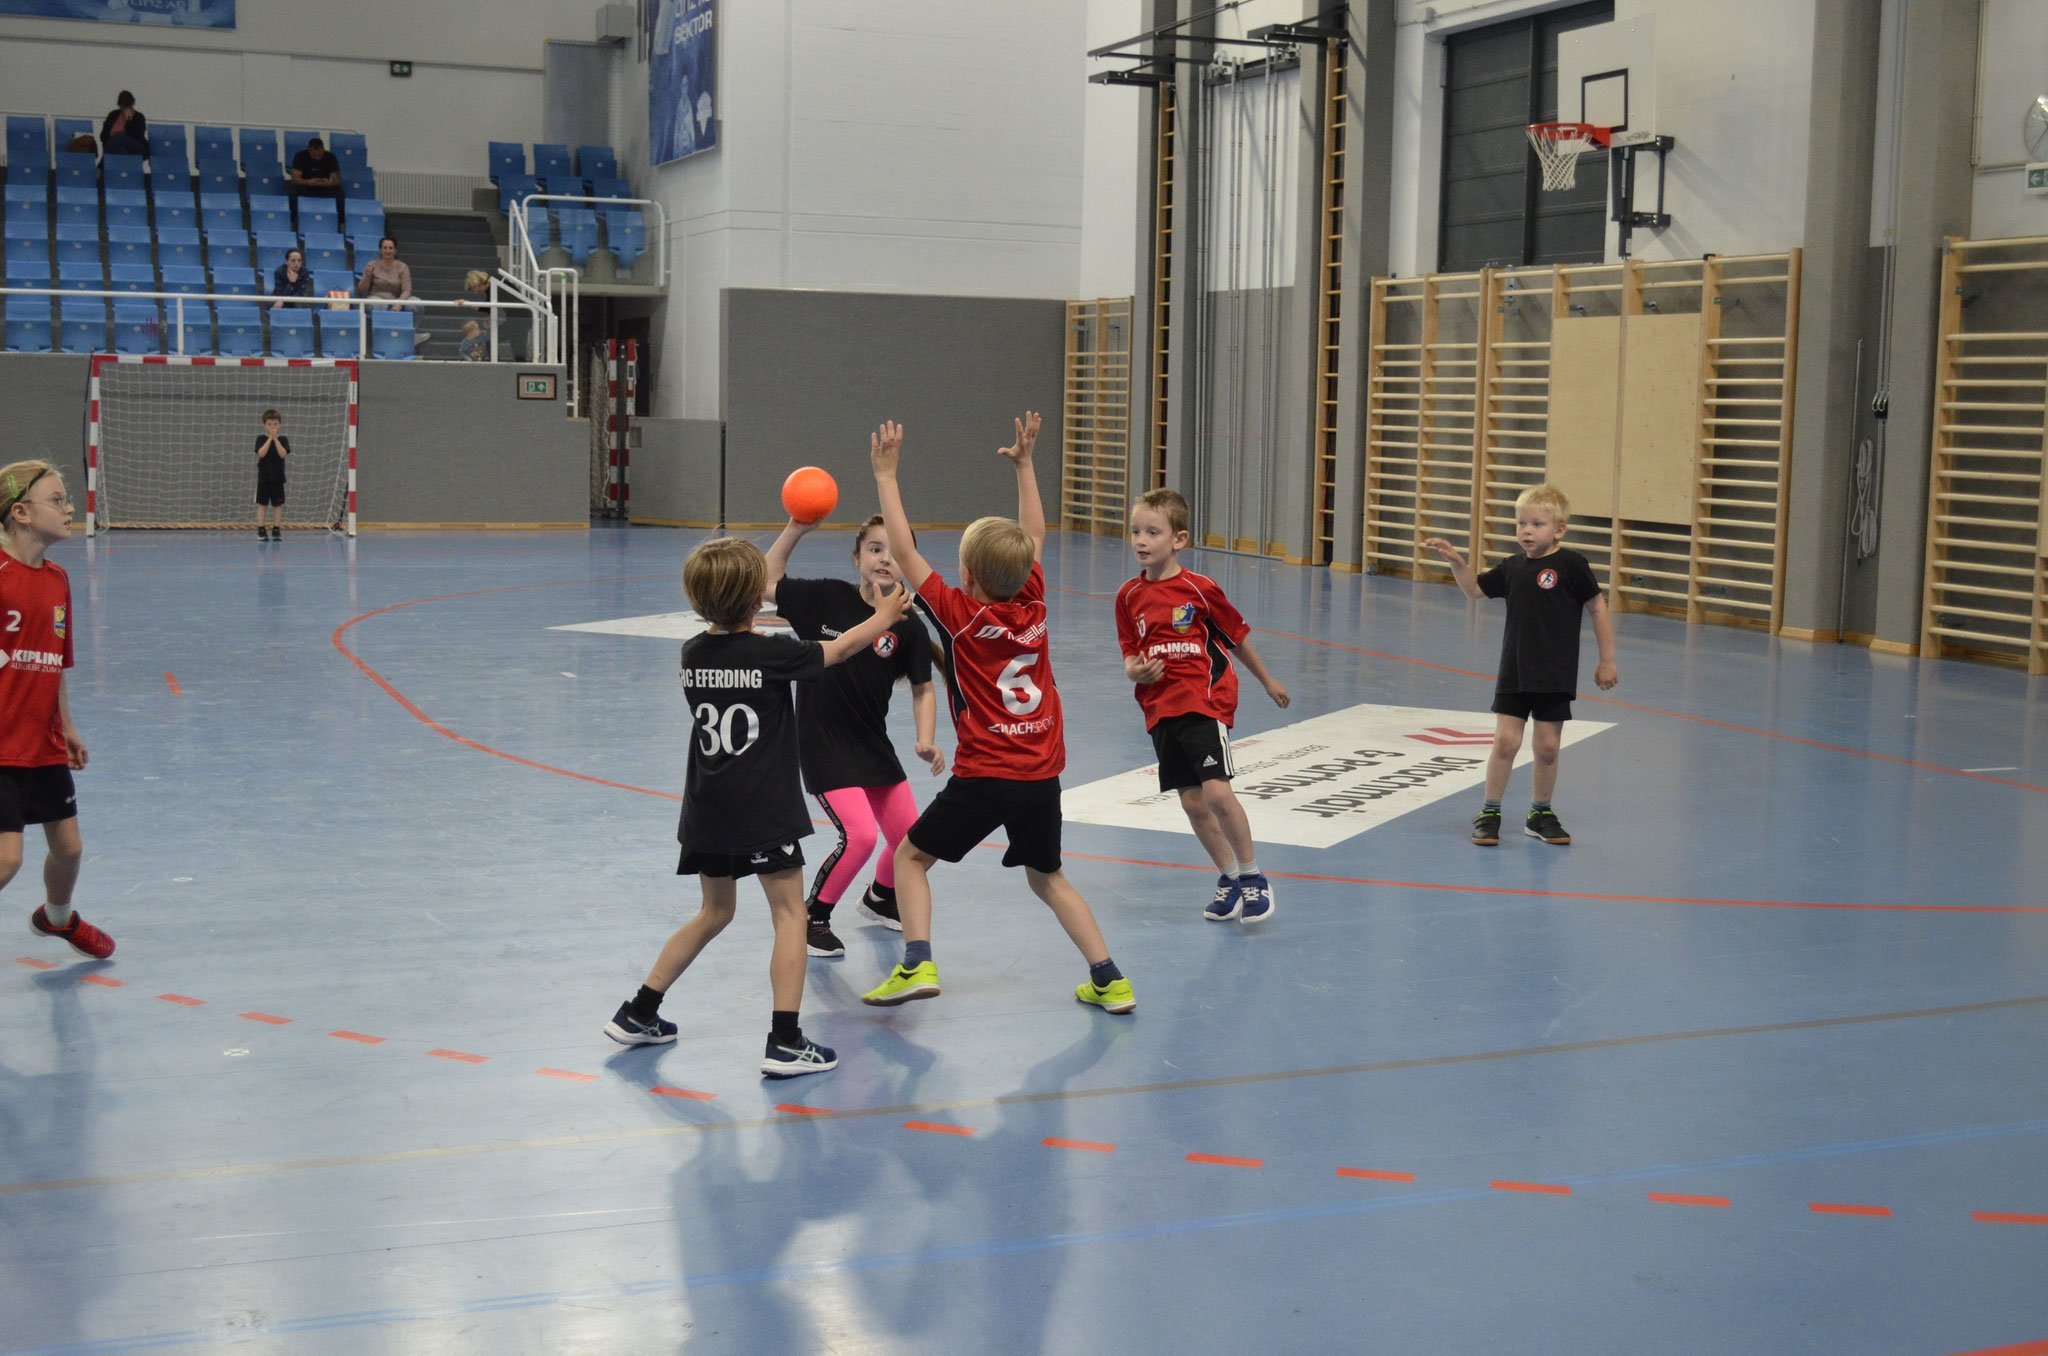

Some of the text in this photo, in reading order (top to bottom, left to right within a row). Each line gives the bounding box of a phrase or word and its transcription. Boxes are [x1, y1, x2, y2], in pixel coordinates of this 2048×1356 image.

[674, 10, 713, 44] SEKTOR
[6, 610, 22, 632] 2
[1148, 642, 1202, 657] EPLINGER
[695, 668, 763, 689] EFERDING
[997, 653, 1042, 716] 6
[696, 702, 760, 756] 30
